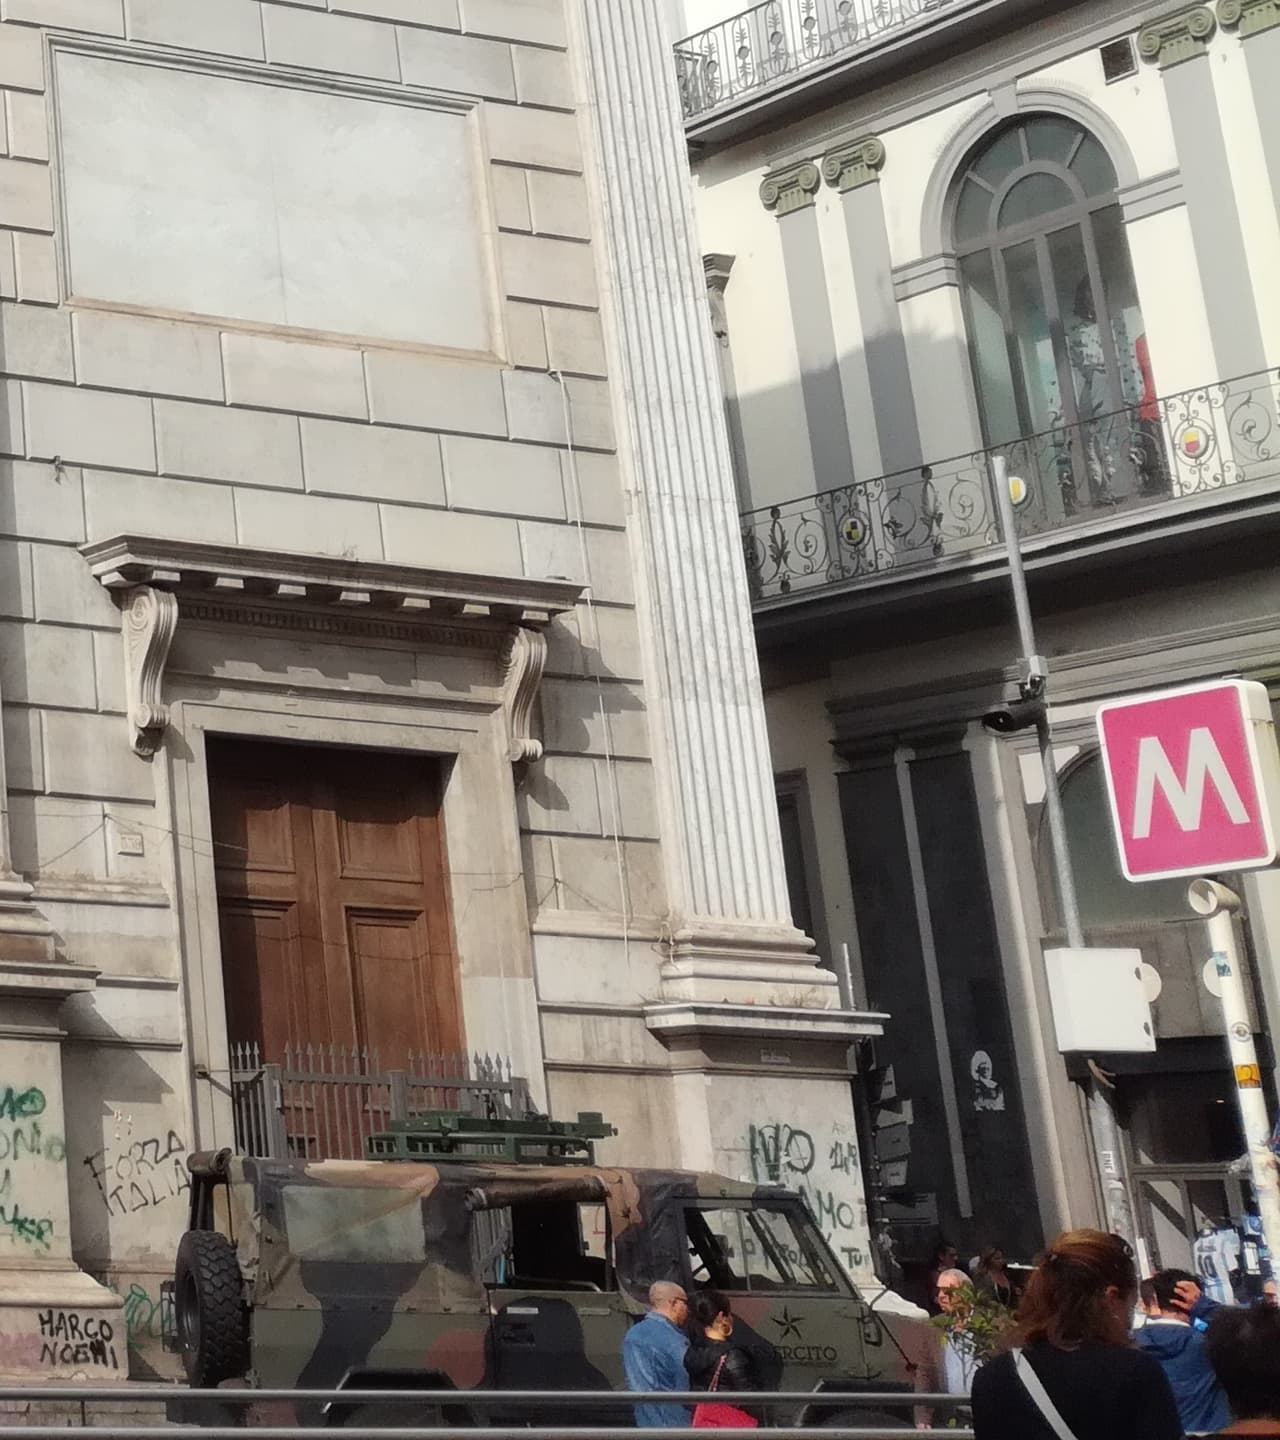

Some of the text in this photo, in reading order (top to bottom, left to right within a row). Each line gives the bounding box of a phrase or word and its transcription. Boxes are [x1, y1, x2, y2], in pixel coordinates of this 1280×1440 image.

[1132, 726, 1251, 840] M
[83, 1129, 185, 1191] FORZA
[103, 1158, 192, 1217] ITALIA
